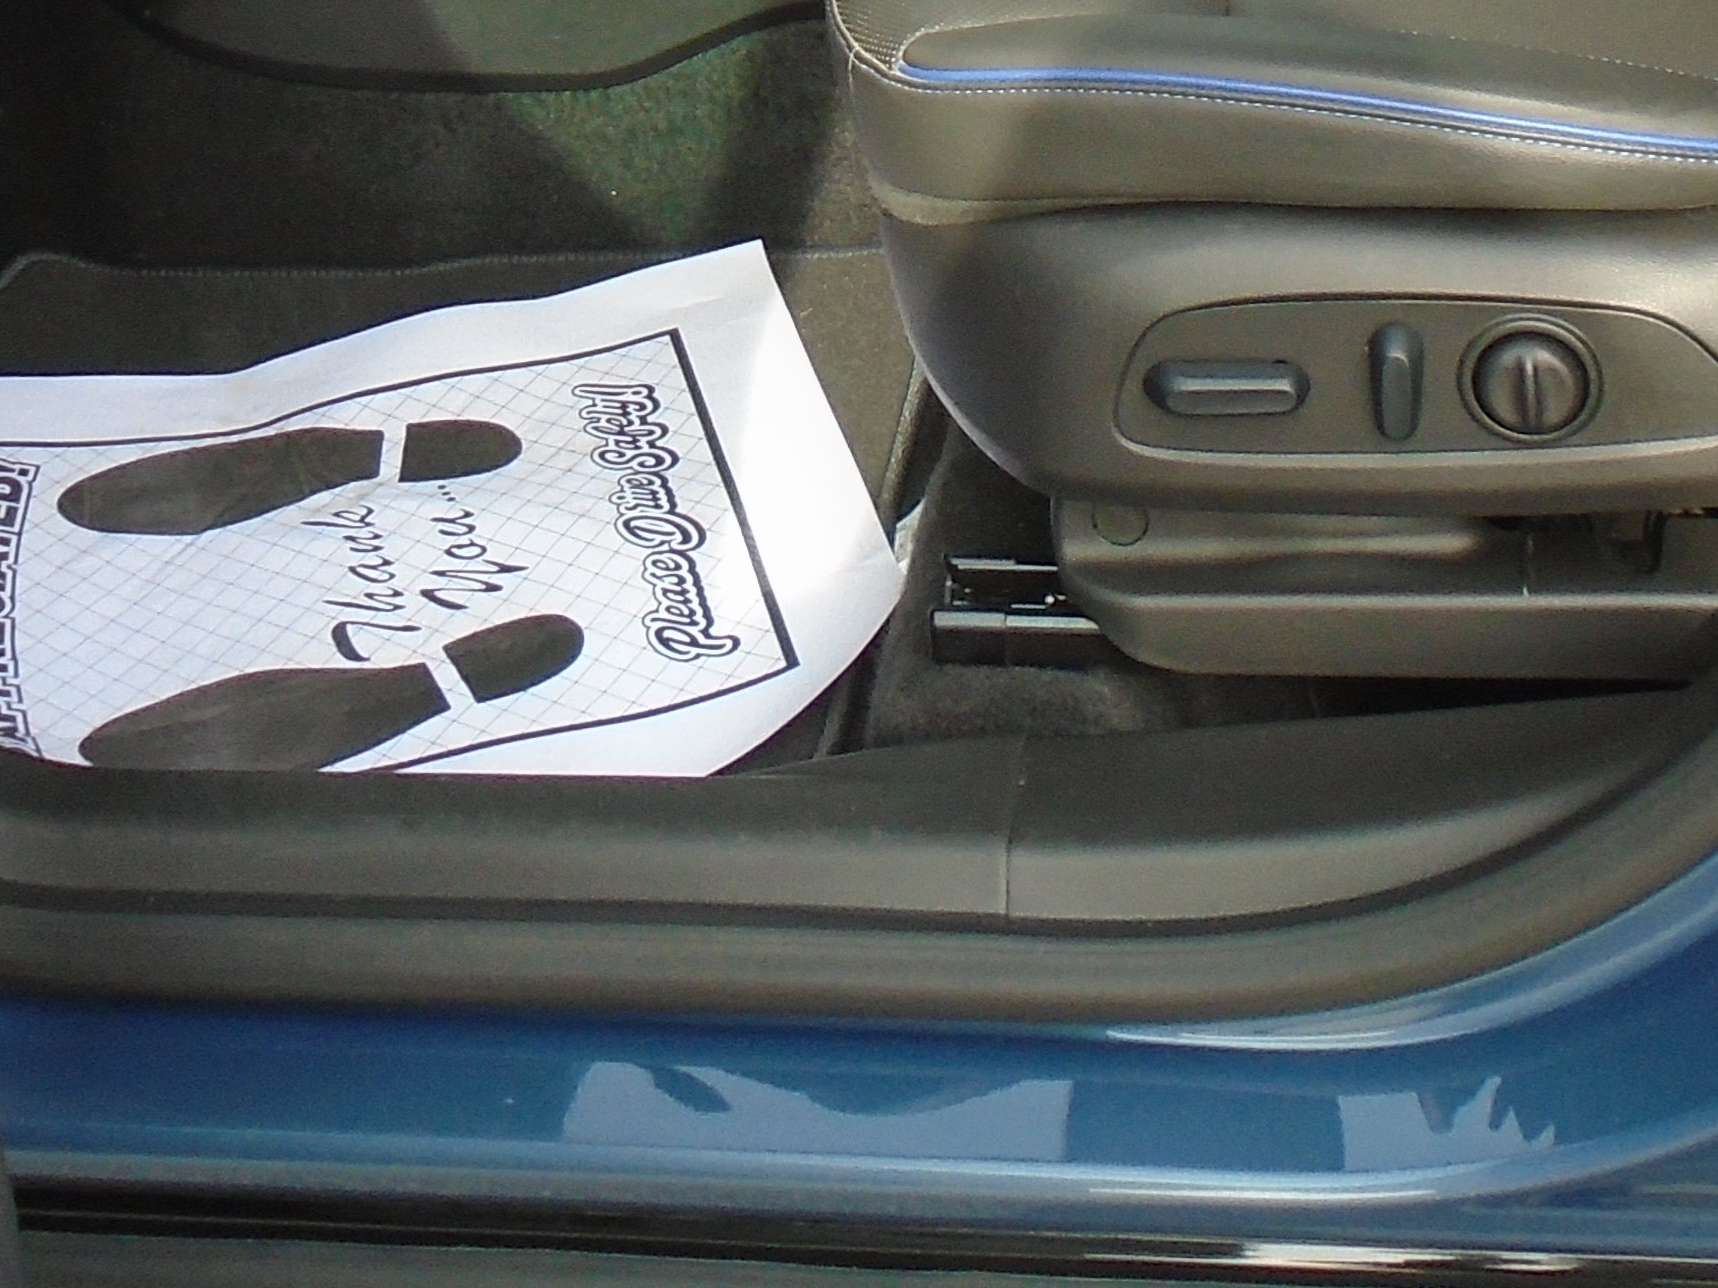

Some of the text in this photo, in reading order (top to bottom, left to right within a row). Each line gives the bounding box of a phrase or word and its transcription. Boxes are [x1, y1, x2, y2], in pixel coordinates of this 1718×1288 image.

[301, 505, 423, 662] Thank
[573, 384, 740, 661] Please Drive Safely!
